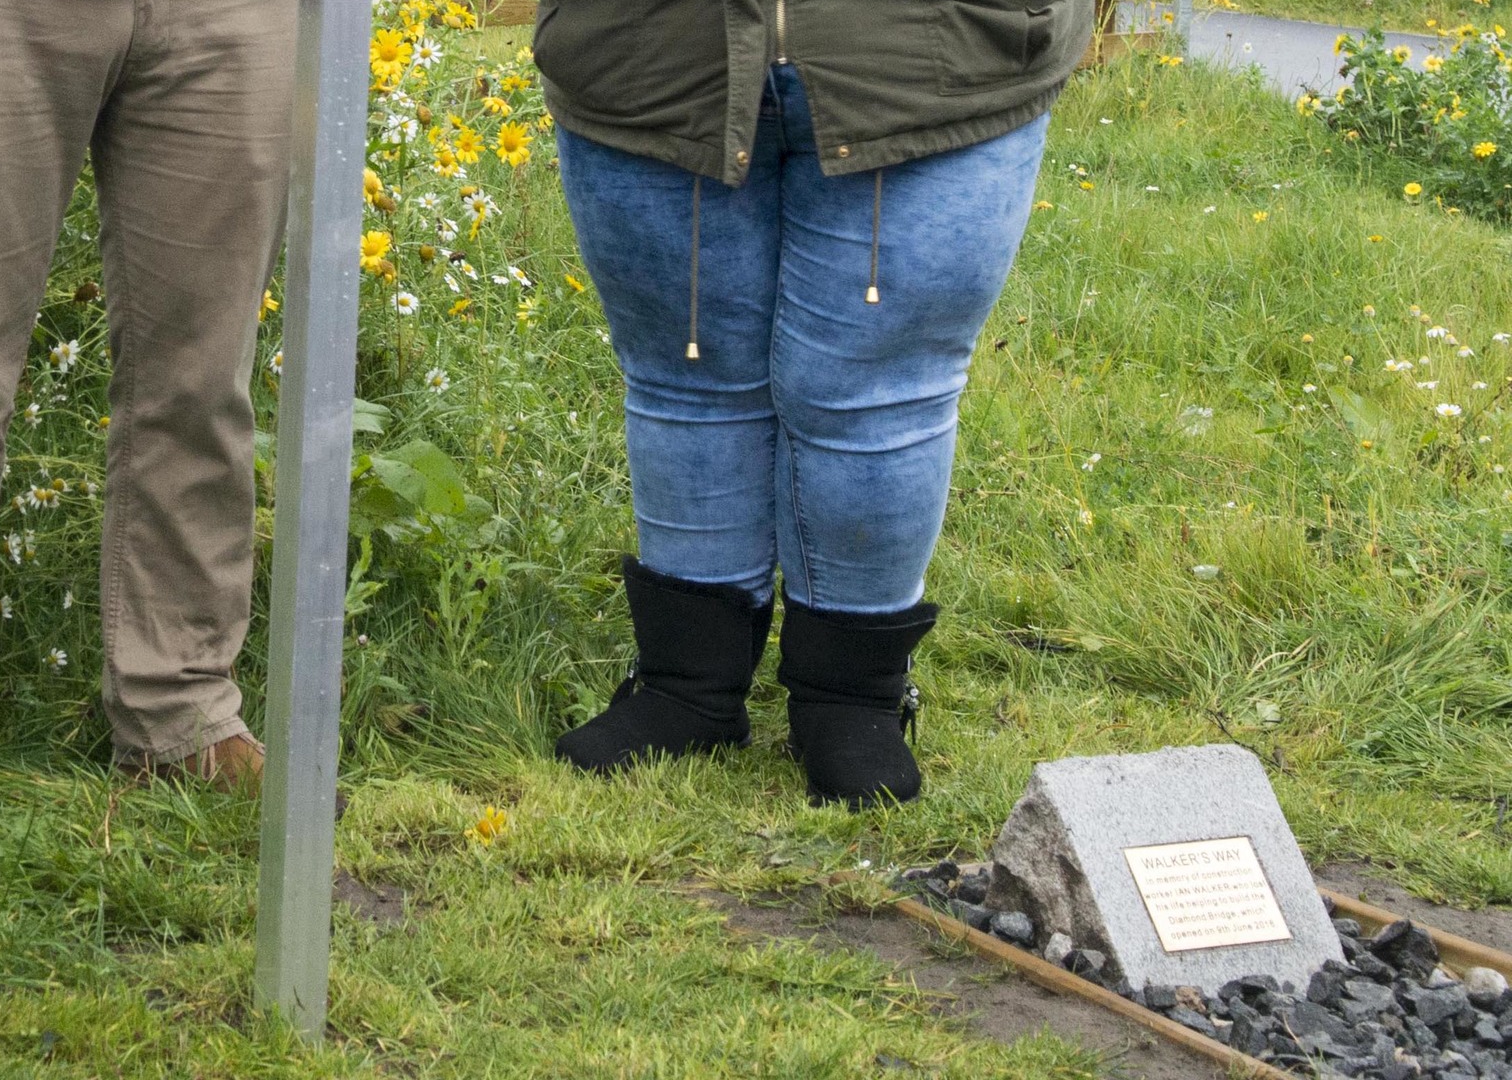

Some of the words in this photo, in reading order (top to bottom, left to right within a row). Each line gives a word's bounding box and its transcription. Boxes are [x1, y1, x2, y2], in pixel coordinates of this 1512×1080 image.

[1142, 852, 1211, 870] WALKER'S
[1212, 849, 1241, 863] WAY
[1156, 873, 1189, 884] memory
[1191, 872, 1200, 881] of
[1201, 867, 1253, 879] construction
[1145, 890, 1173, 899] worker
[1175, 887, 1191, 896] IAN
[1233, 881, 1248, 889] who
[1249, 879, 1266, 888] lost
[1155, 903, 1169, 911] his
[1170, 901, 1184, 910] life
[1186, 897, 1217, 908] helping
[1219, 896, 1228, 905] to
[1229, 893, 1250, 904] build
[1251, 892, 1265, 901] the
[1168, 910, 1207, 925] Diamond
[1240, 906, 1264, 916] which
[1170, 927, 1203, 939] opened
[1205, 928, 1215, 936] on
[1216, 925, 1230, 935] 9th
[1233, 923, 1253, 933] June
